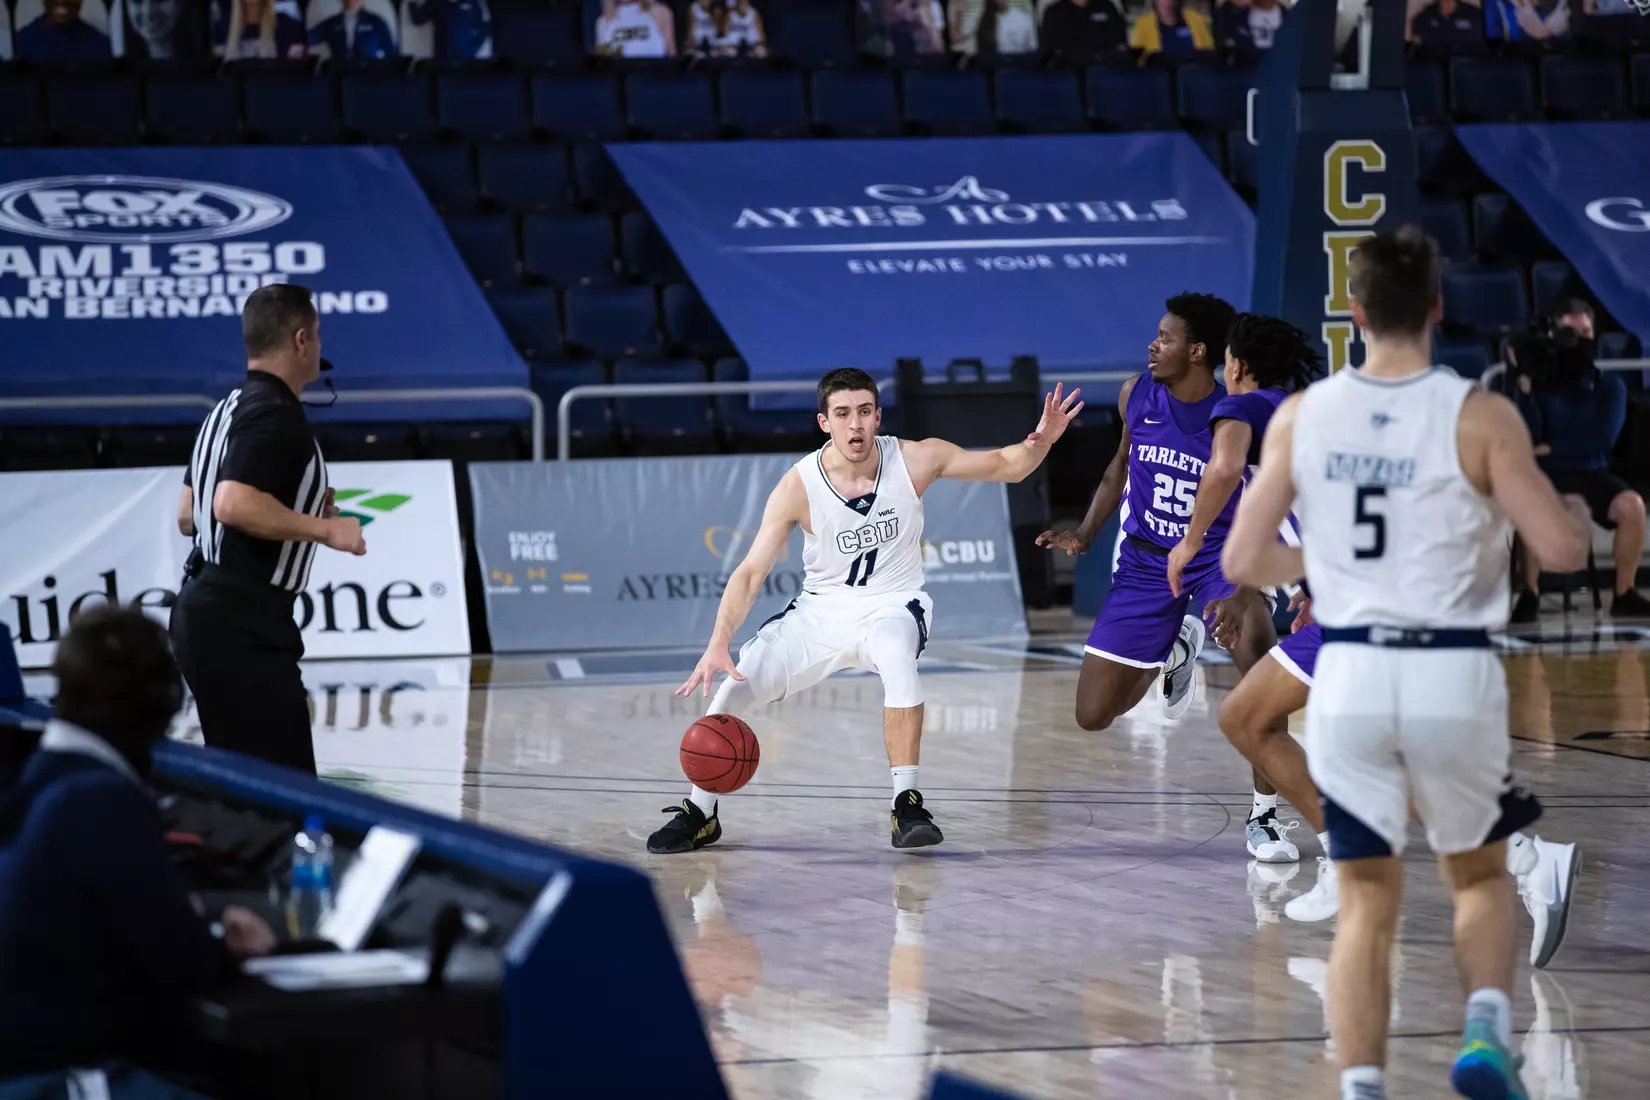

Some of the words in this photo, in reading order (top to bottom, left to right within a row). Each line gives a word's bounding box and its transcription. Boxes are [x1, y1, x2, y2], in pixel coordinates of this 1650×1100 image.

[28, 189, 212, 217] FOX
[732, 204, 927, 229] AYRES
[942, 198, 1189, 226] HOTELS
[43, 212, 229, 228] SPORTS
[846, 255, 967, 274] ELEVATE
[975, 253, 1055, 272] YOUR
[1062, 252, 1129, 270] STAY
[64, 290, 389, 319] BERNANO
[1137, 444, 1207, 477] TARLET
[1153, 472, 1198, 517] 25
[877, 508, 896, 518] WAC
[1144, 509, 1207, 537] STAT
[1354, 485, 1387, 560] 5
[508, 530, 557, 544] ENJOY
[836, 517, 899, 555] CBU
[509, 543, 559, 561] FREE
[940, 540, 996, 564] CBU
[844, 547, 879, 587] 11
[616, 572, 729, 602] AYRES
